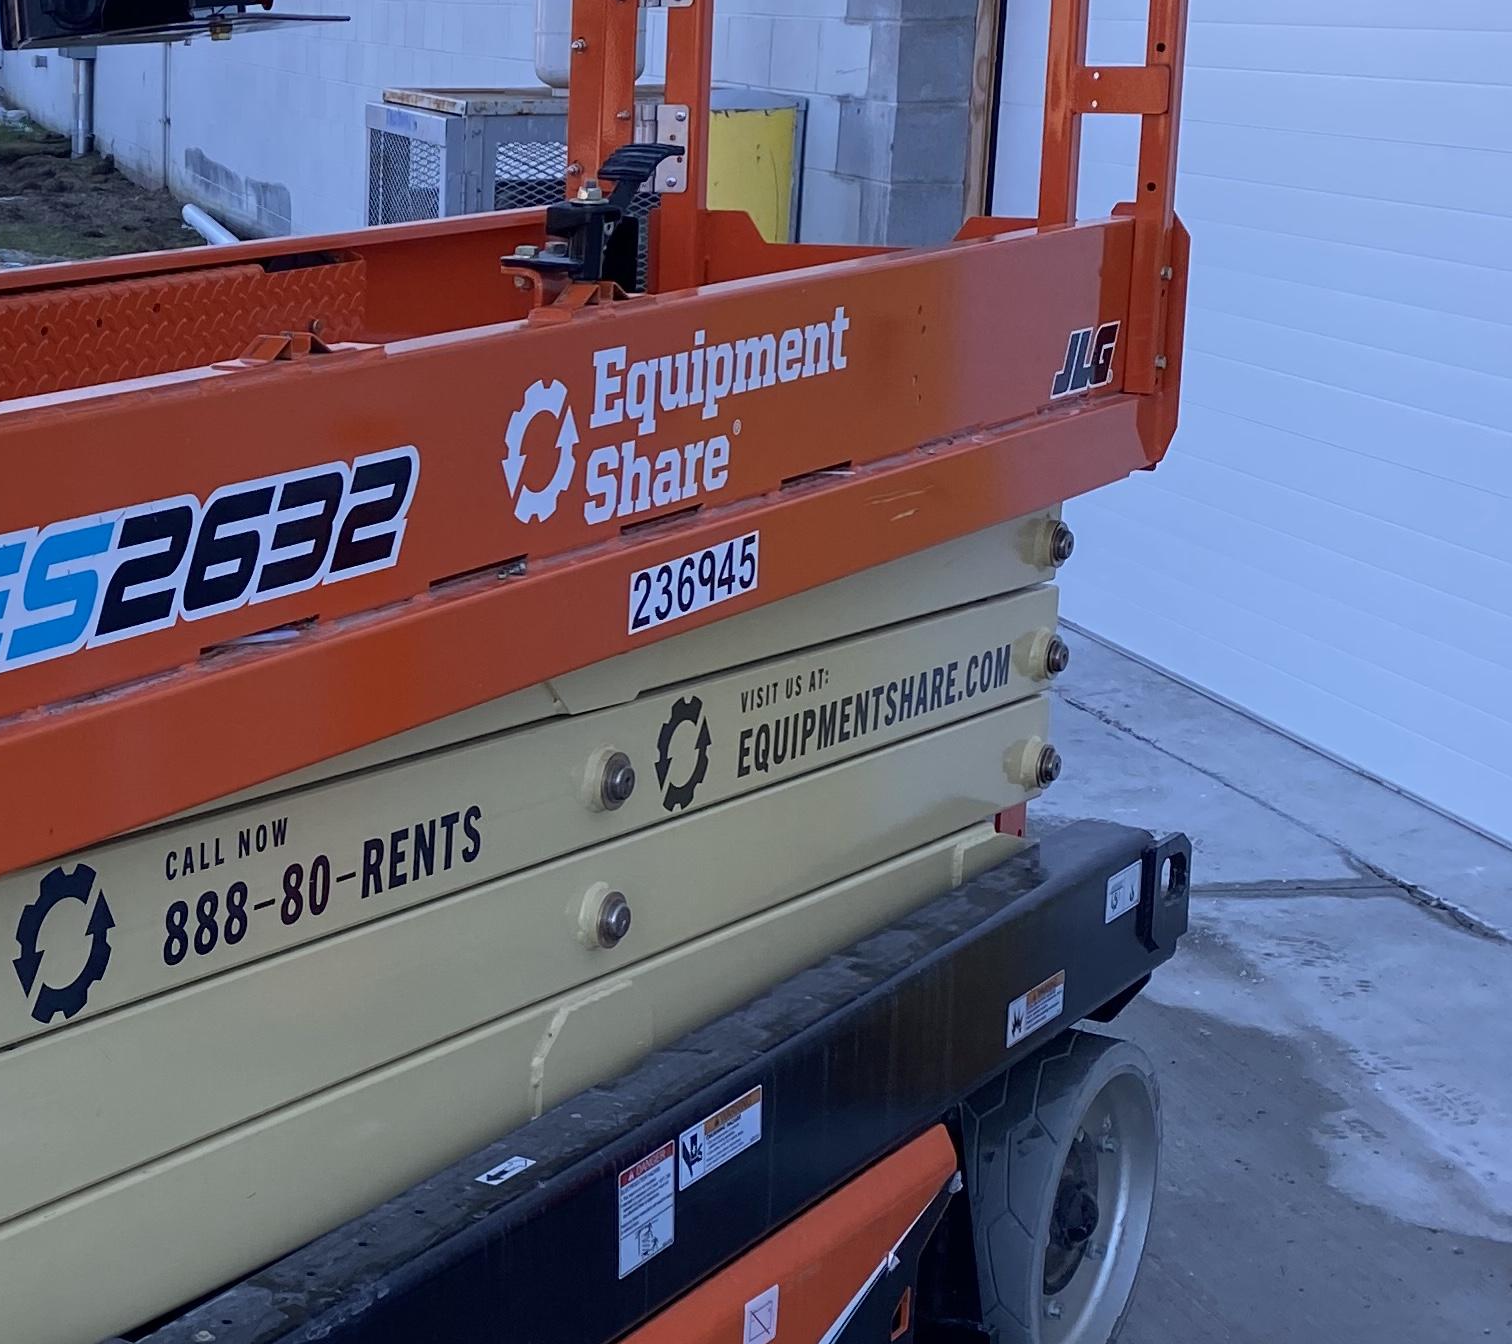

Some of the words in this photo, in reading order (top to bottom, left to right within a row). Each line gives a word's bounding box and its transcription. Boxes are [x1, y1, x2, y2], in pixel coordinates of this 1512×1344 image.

[590, 306, 850, 436] Equipment
[1050, 320, 1120, 398] JLG
[584, 434, 731, 526] Share
[632, 535, 757, 629] 236945
[737, 644, 1012, 778] EQUIPMENTSHARE.COM
[741, 683, 779, 713] VISIT
[786, 675, 802, 699] US
[808, 668, 829, 693] AT:
[163, 805, 482, 966] 888-80-RENTS
[165, 838, 225, 881] CALL
[238, 817, 289, 858] NOW
